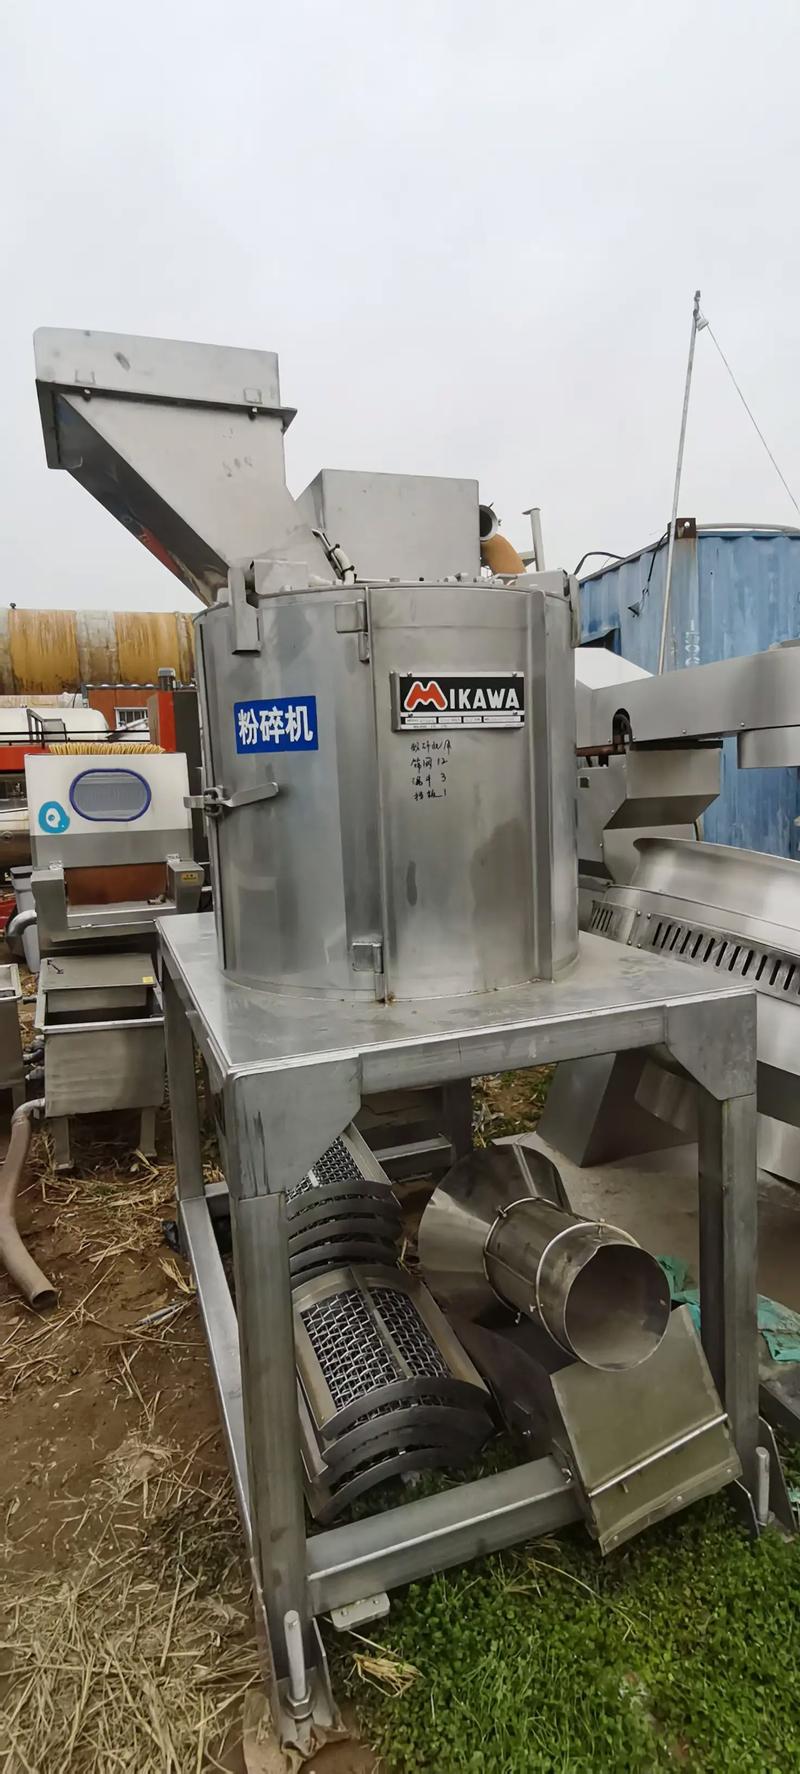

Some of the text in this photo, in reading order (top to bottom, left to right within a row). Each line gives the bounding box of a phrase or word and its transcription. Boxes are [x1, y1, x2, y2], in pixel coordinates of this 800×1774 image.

[403, 680, 520, 711] MIKAWA
[237, 704, 314, 746] 粉碎机
[437, 757, 449, 766] 12
[440, 772, 447, 783] 3
